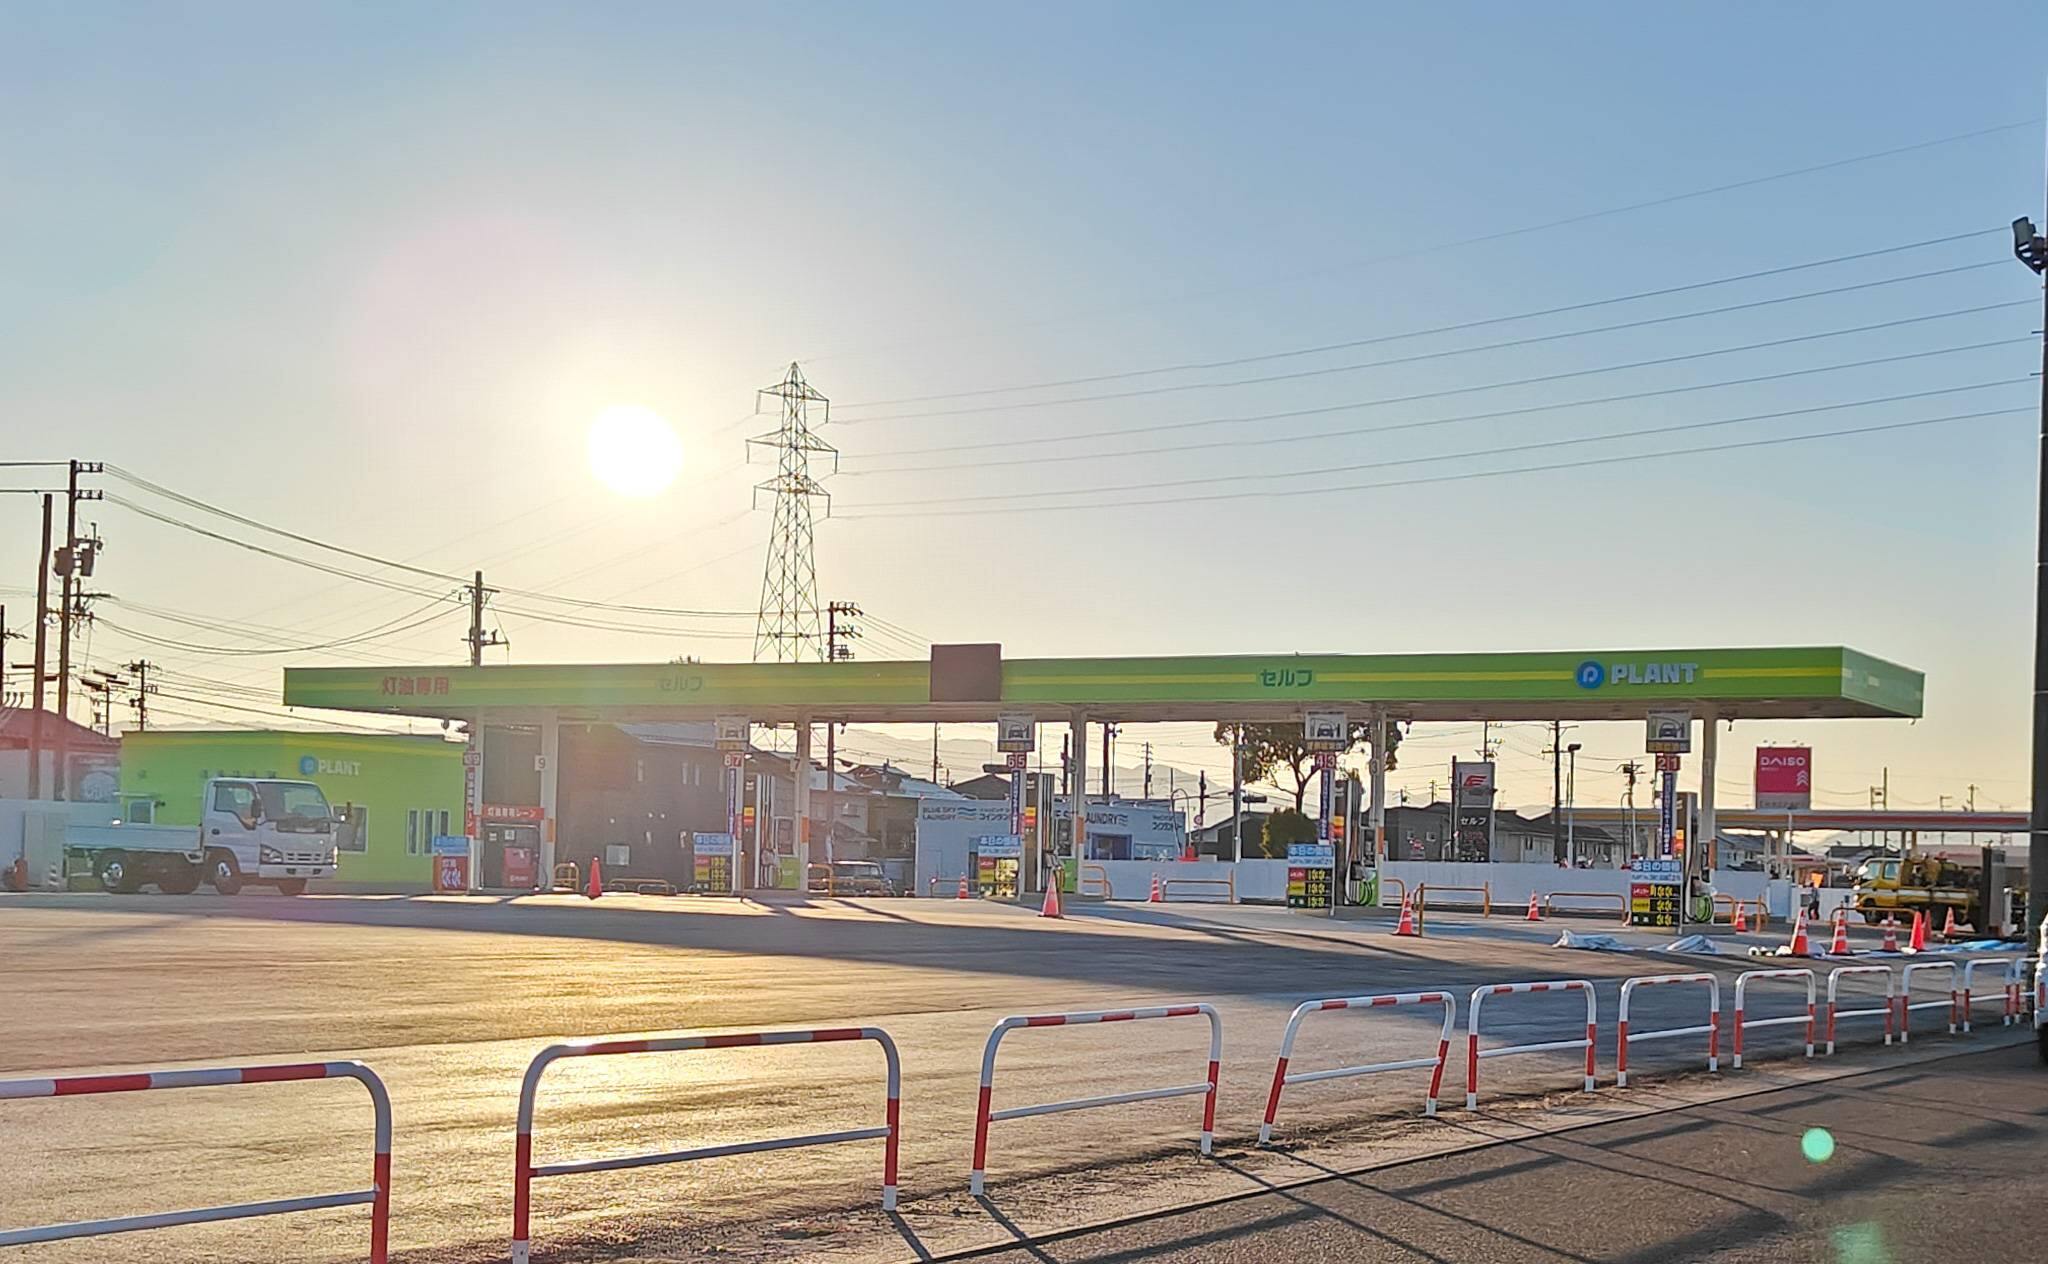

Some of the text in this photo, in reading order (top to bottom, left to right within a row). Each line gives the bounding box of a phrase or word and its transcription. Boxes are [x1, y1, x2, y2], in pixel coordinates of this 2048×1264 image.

[1260, 669, 1312, 687] セルフ
[1611, 663, 1698, 684] PLANT
[319, 760, 361, 776] PLANT
[1761, 757, 1806, 766] DAISO
[1085, 812, 1118, 825] AUNDRY
[1461, 816, 1487, 825] セルフ
